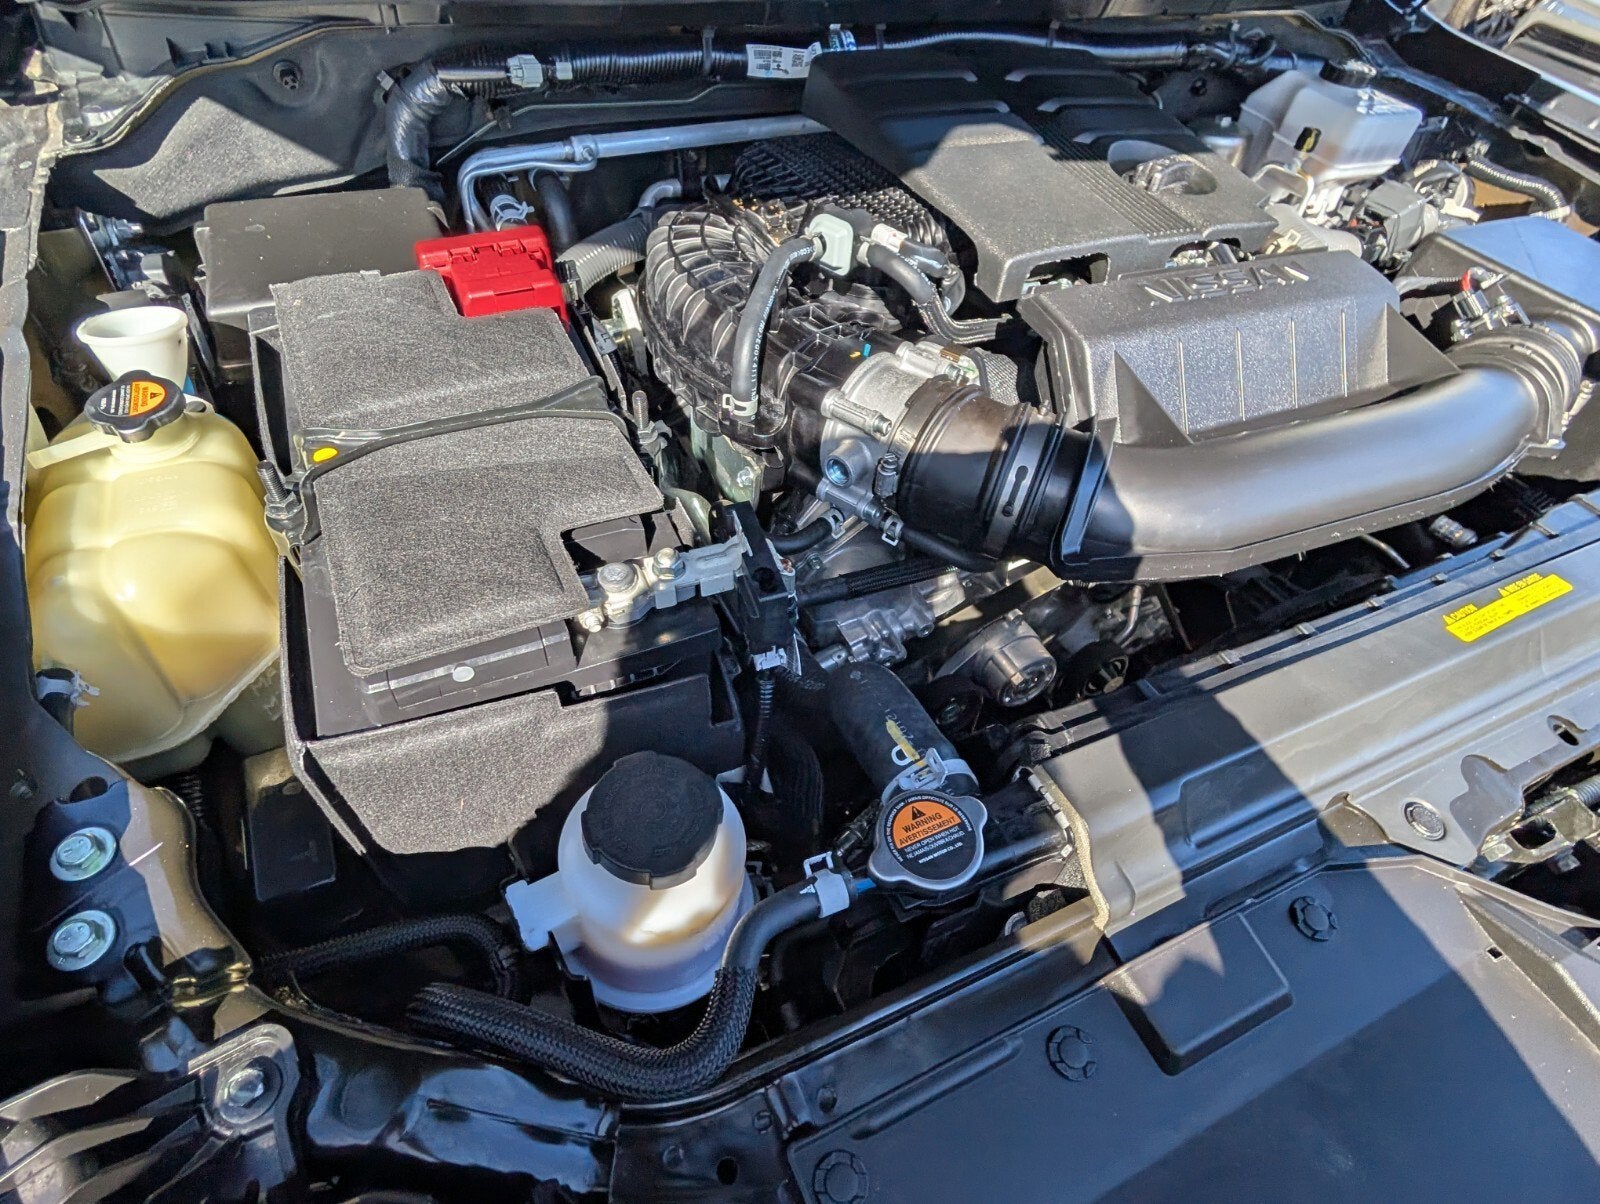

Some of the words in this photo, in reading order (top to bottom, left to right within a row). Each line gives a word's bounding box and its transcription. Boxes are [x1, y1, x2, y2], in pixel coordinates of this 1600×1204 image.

[1138, 261, 1309, 306] NISSAN
[899, 816, 956, 845] AVERTISSEMENT
[902, 812, 942, 833] WARNING
[903, 841, 921, 852] NEVER
[921, 836, 934, 845] OPEN
